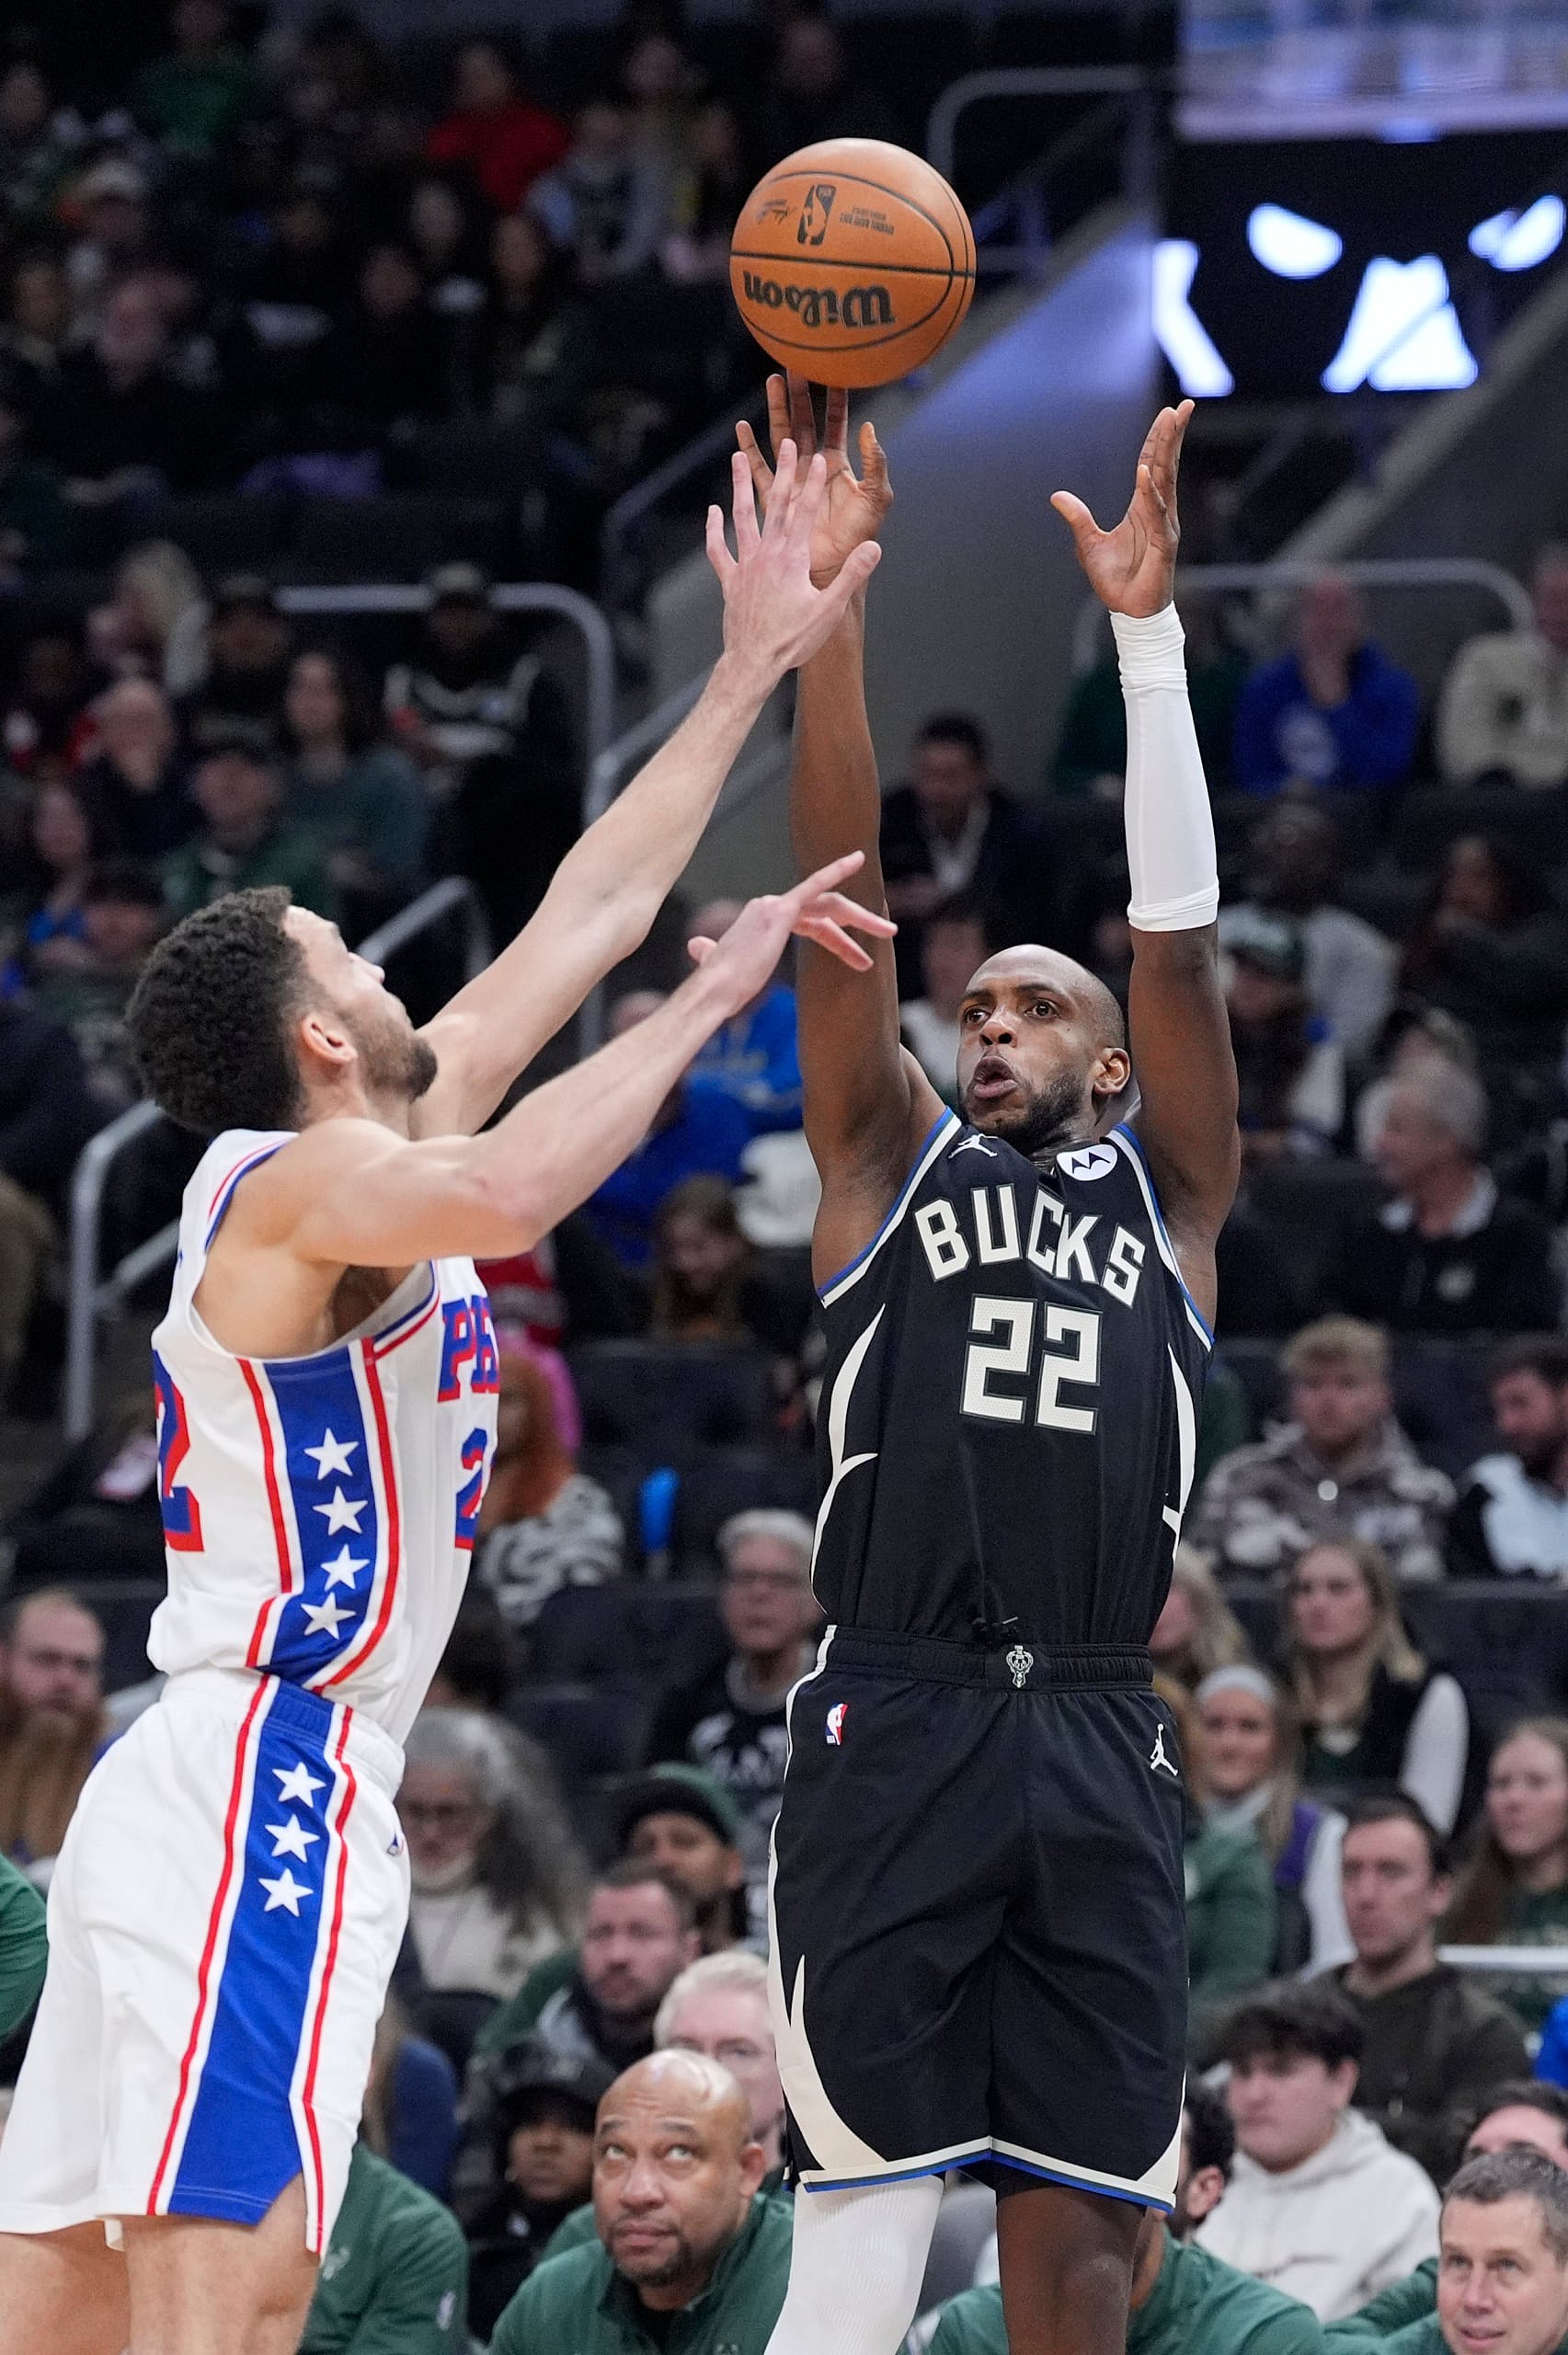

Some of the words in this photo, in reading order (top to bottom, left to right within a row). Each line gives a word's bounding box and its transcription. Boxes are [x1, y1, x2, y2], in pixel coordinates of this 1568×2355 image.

[743, 270, 896, 327] Wilson
[914, 1183, 1146, 1308] BUCKS
[960, 1293, 1104, 1435] 22
[454, 1428, 498, 1551] 2
